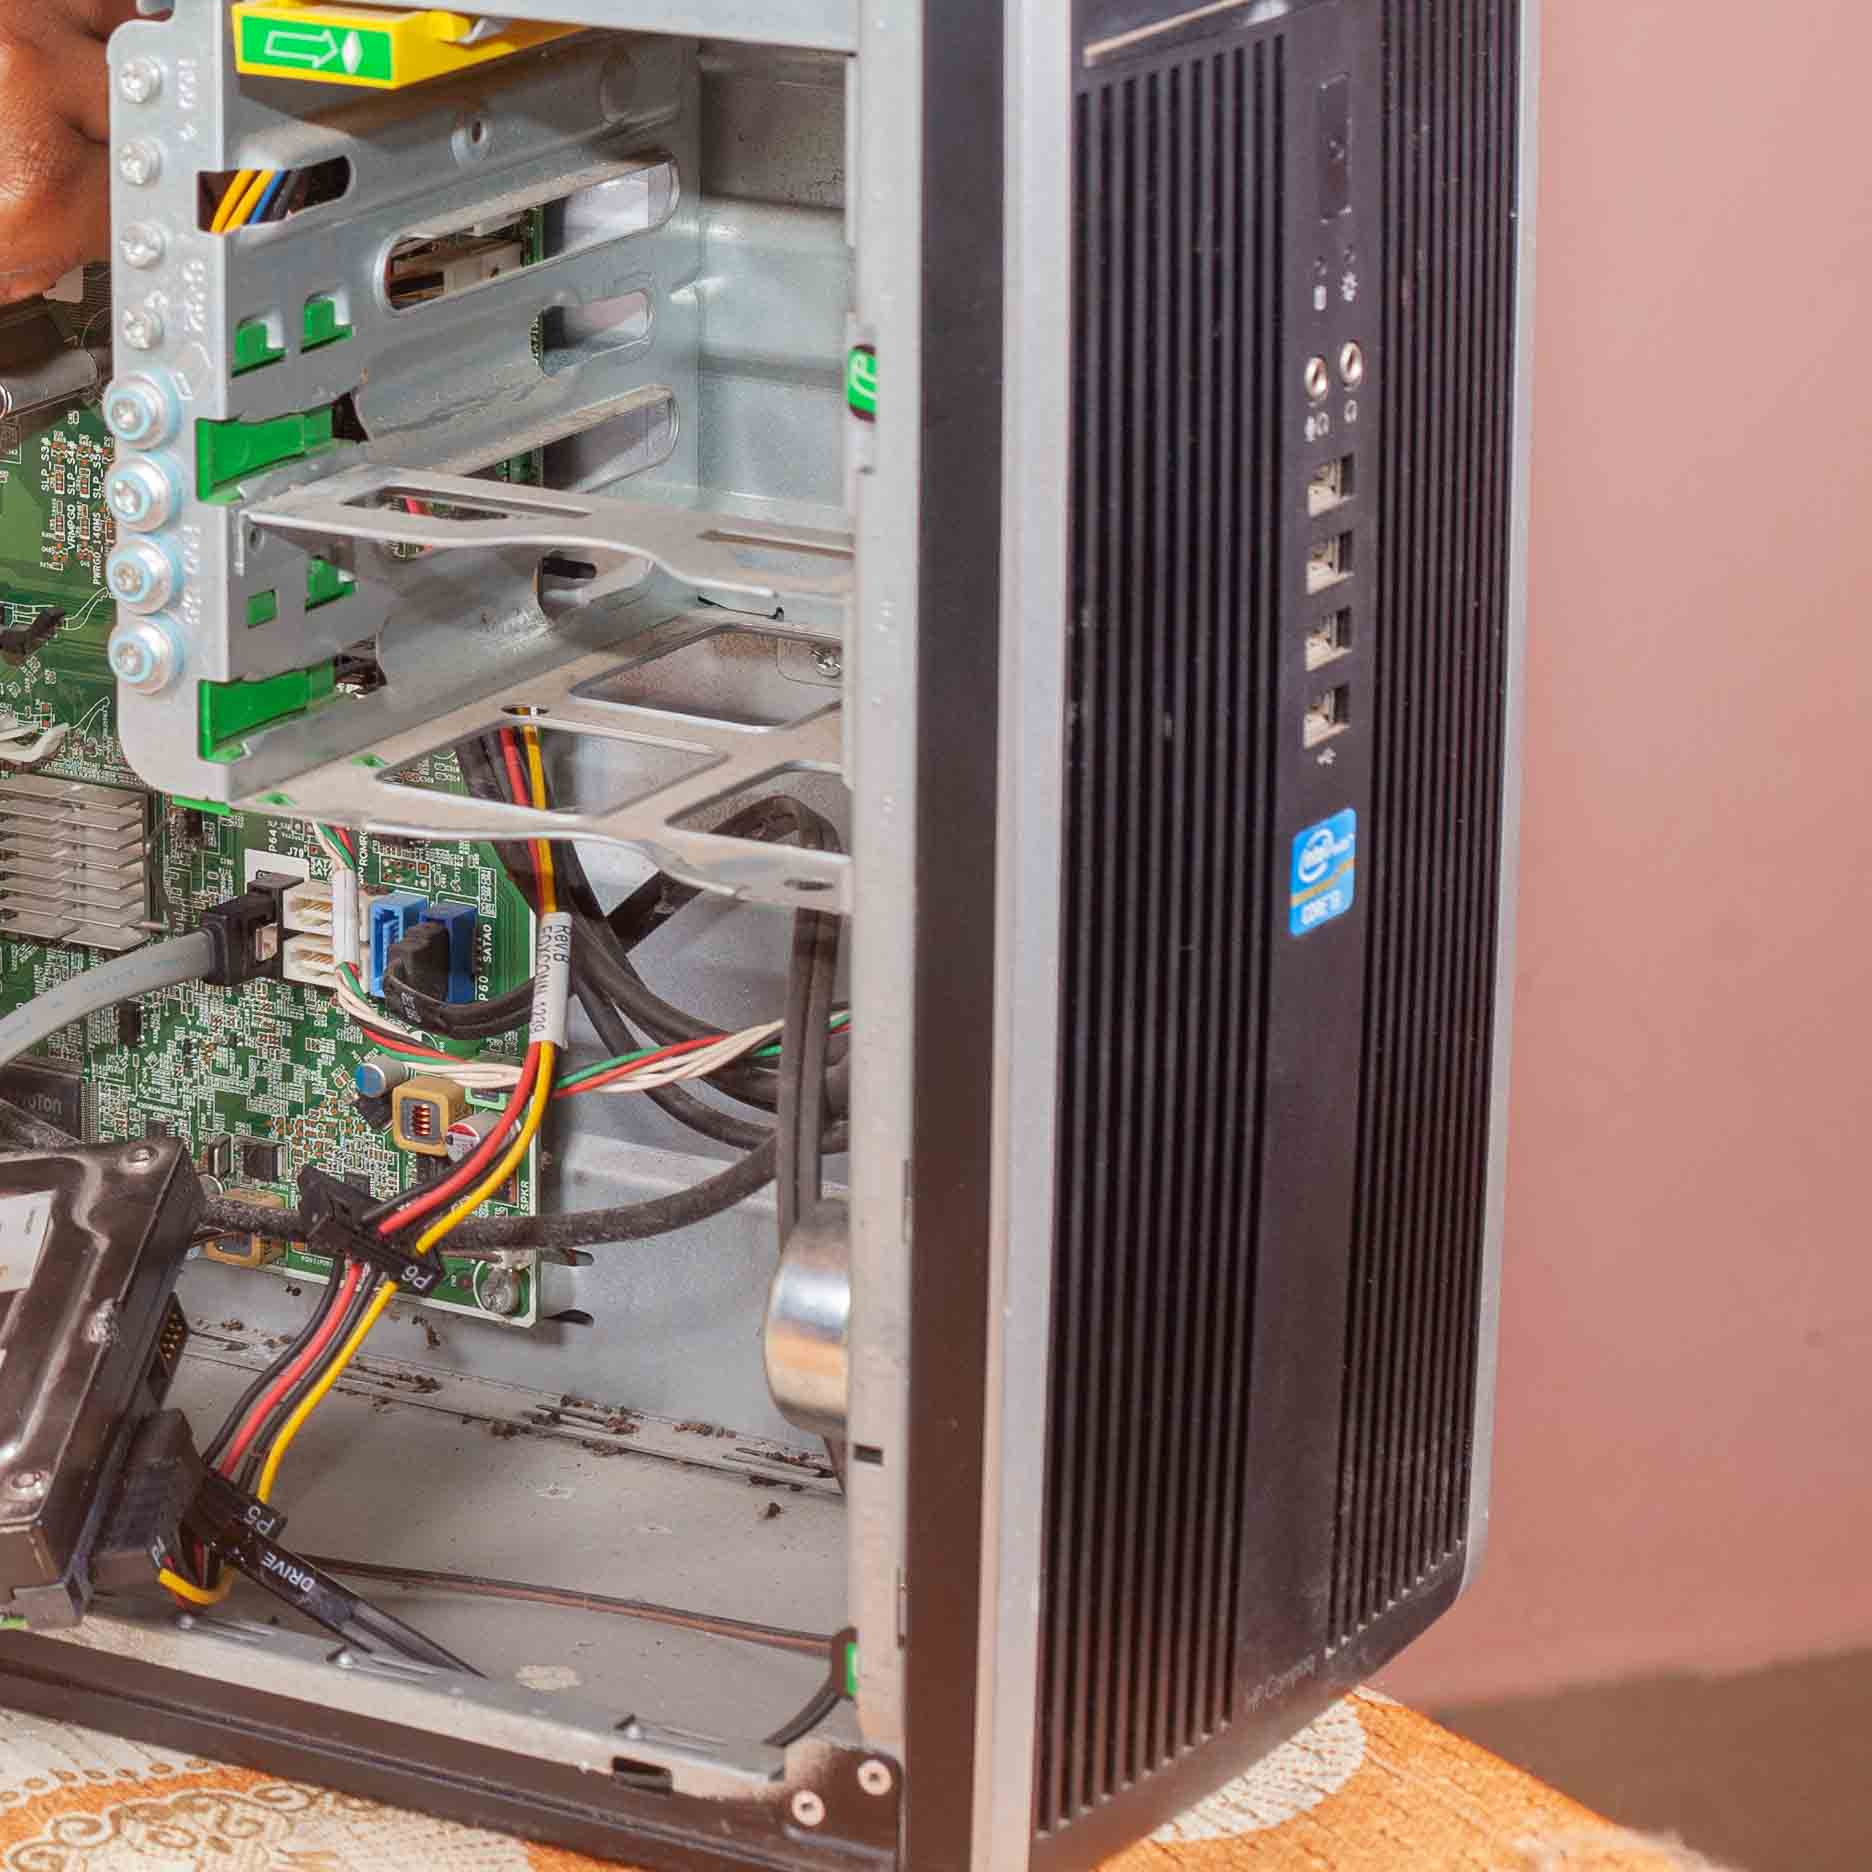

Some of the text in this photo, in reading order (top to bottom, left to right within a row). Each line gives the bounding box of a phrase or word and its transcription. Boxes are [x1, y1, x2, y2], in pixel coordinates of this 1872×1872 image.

[478, 975, 489, 1002] P60
[401, 1265, 433, 1289] P6
[260, 1551, 316, 1593] DRIVE
